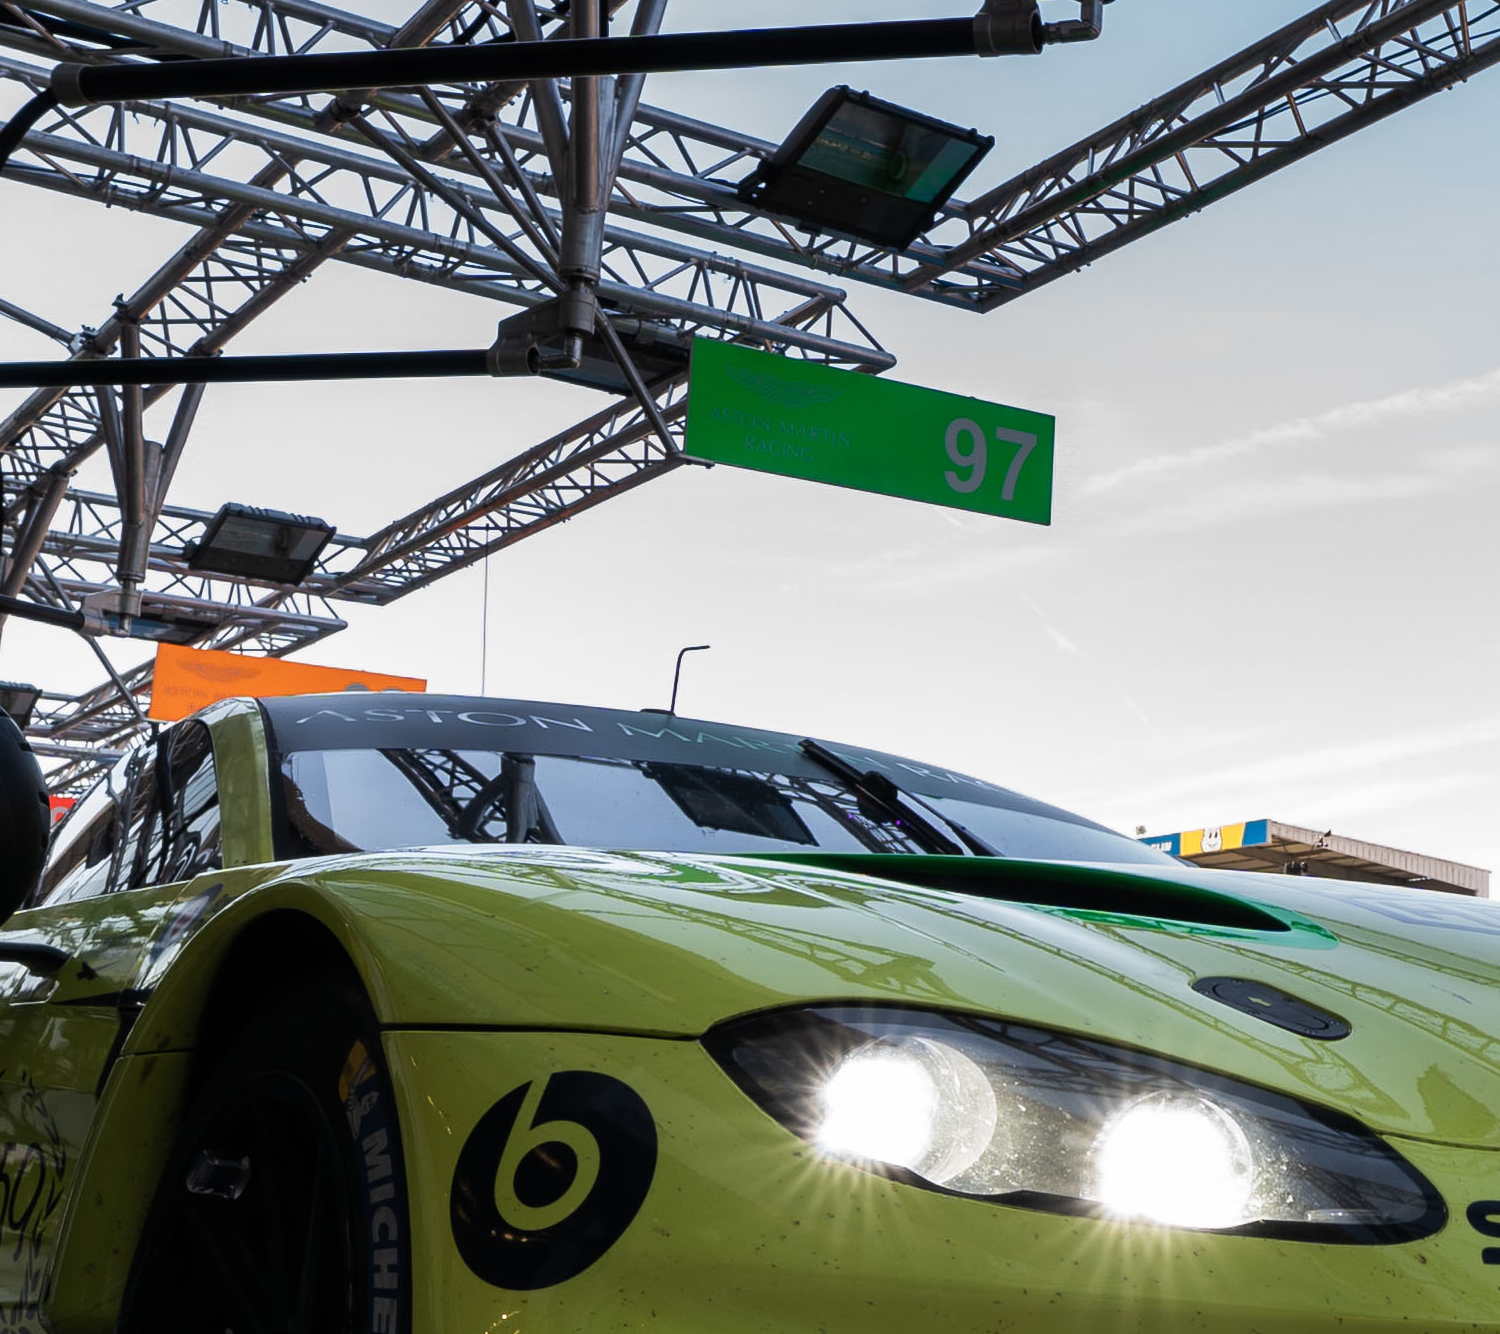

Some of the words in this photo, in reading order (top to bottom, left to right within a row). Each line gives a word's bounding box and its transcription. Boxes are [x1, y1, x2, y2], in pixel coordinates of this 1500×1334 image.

[943, 417, 1038, 502] 97
[296, 709, 595, 734] ASTON
[617, 722, 892, 770] MARN
